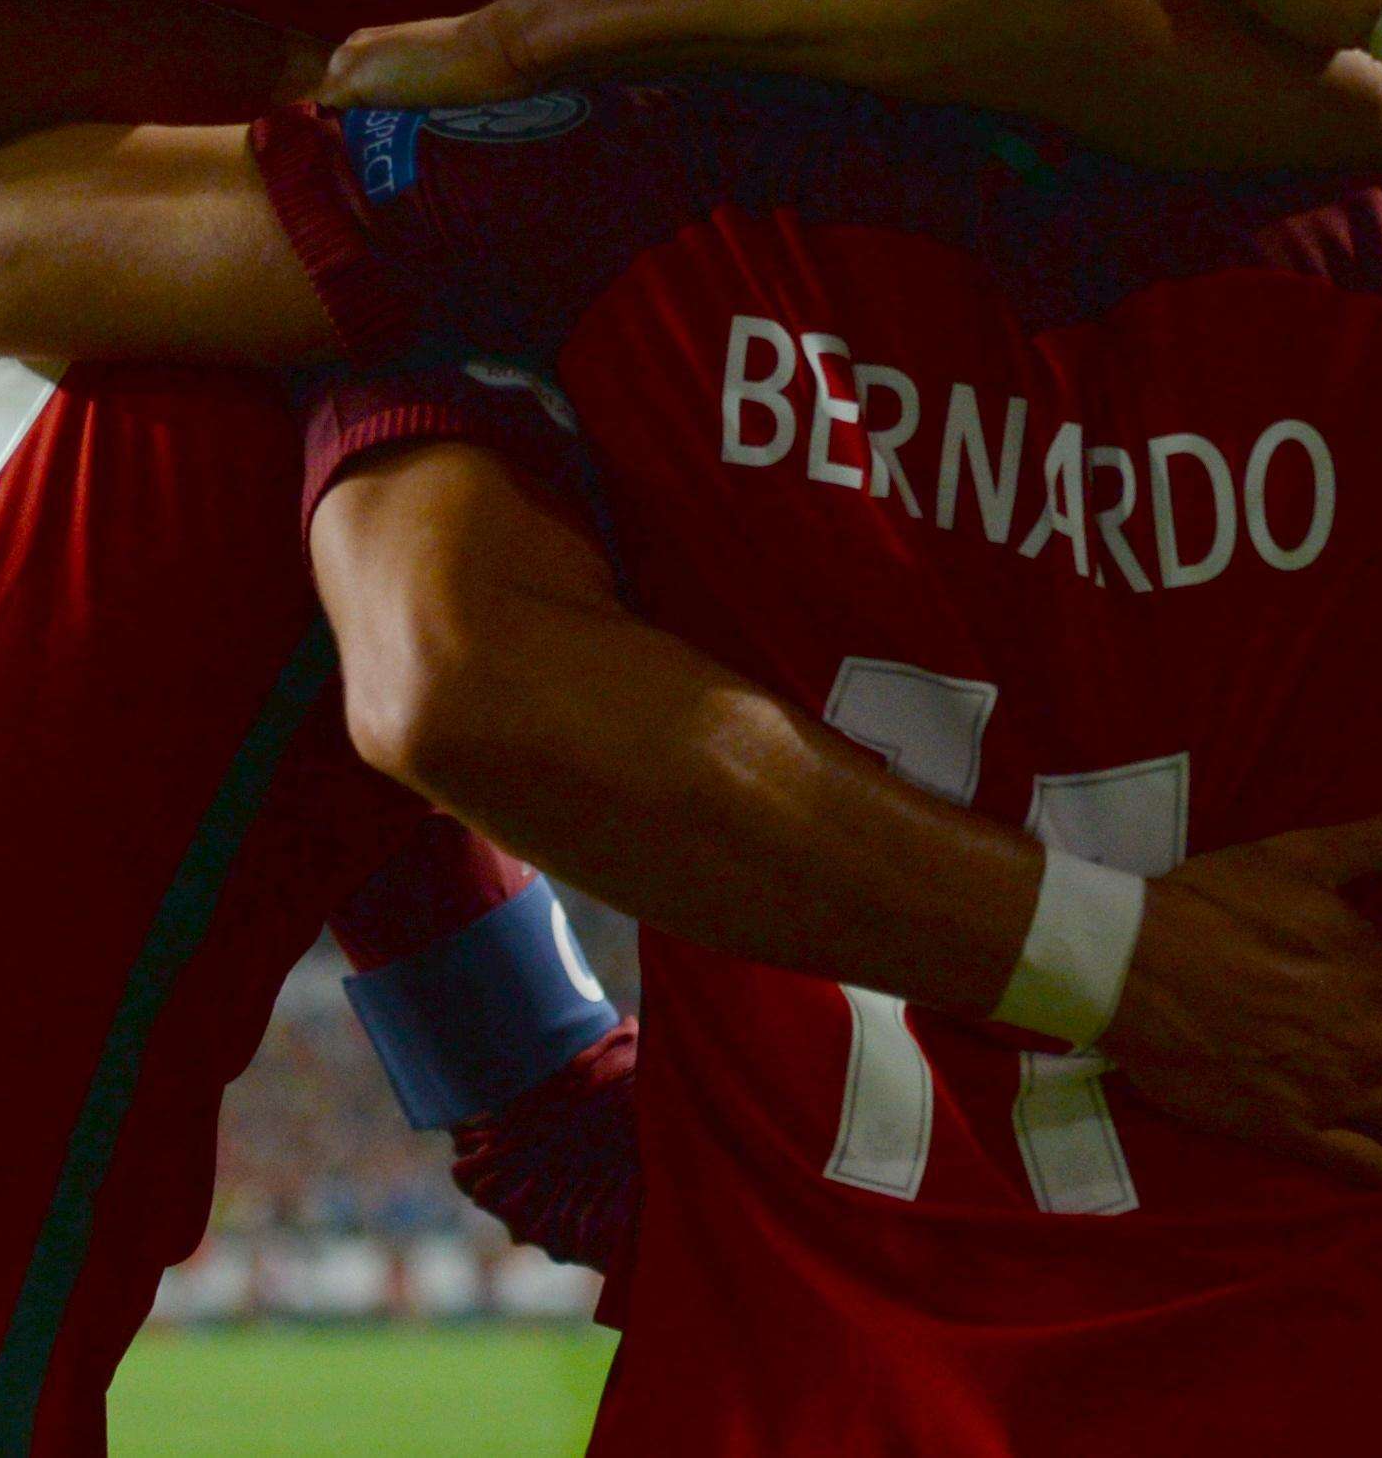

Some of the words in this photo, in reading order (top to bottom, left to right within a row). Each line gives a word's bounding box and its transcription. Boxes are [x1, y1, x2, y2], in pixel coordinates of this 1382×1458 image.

[364, 111, 397, 194] SPECT
[720, 313, 1337, 595] BERNARDO
[820, 654, 1191, 1218] 11
